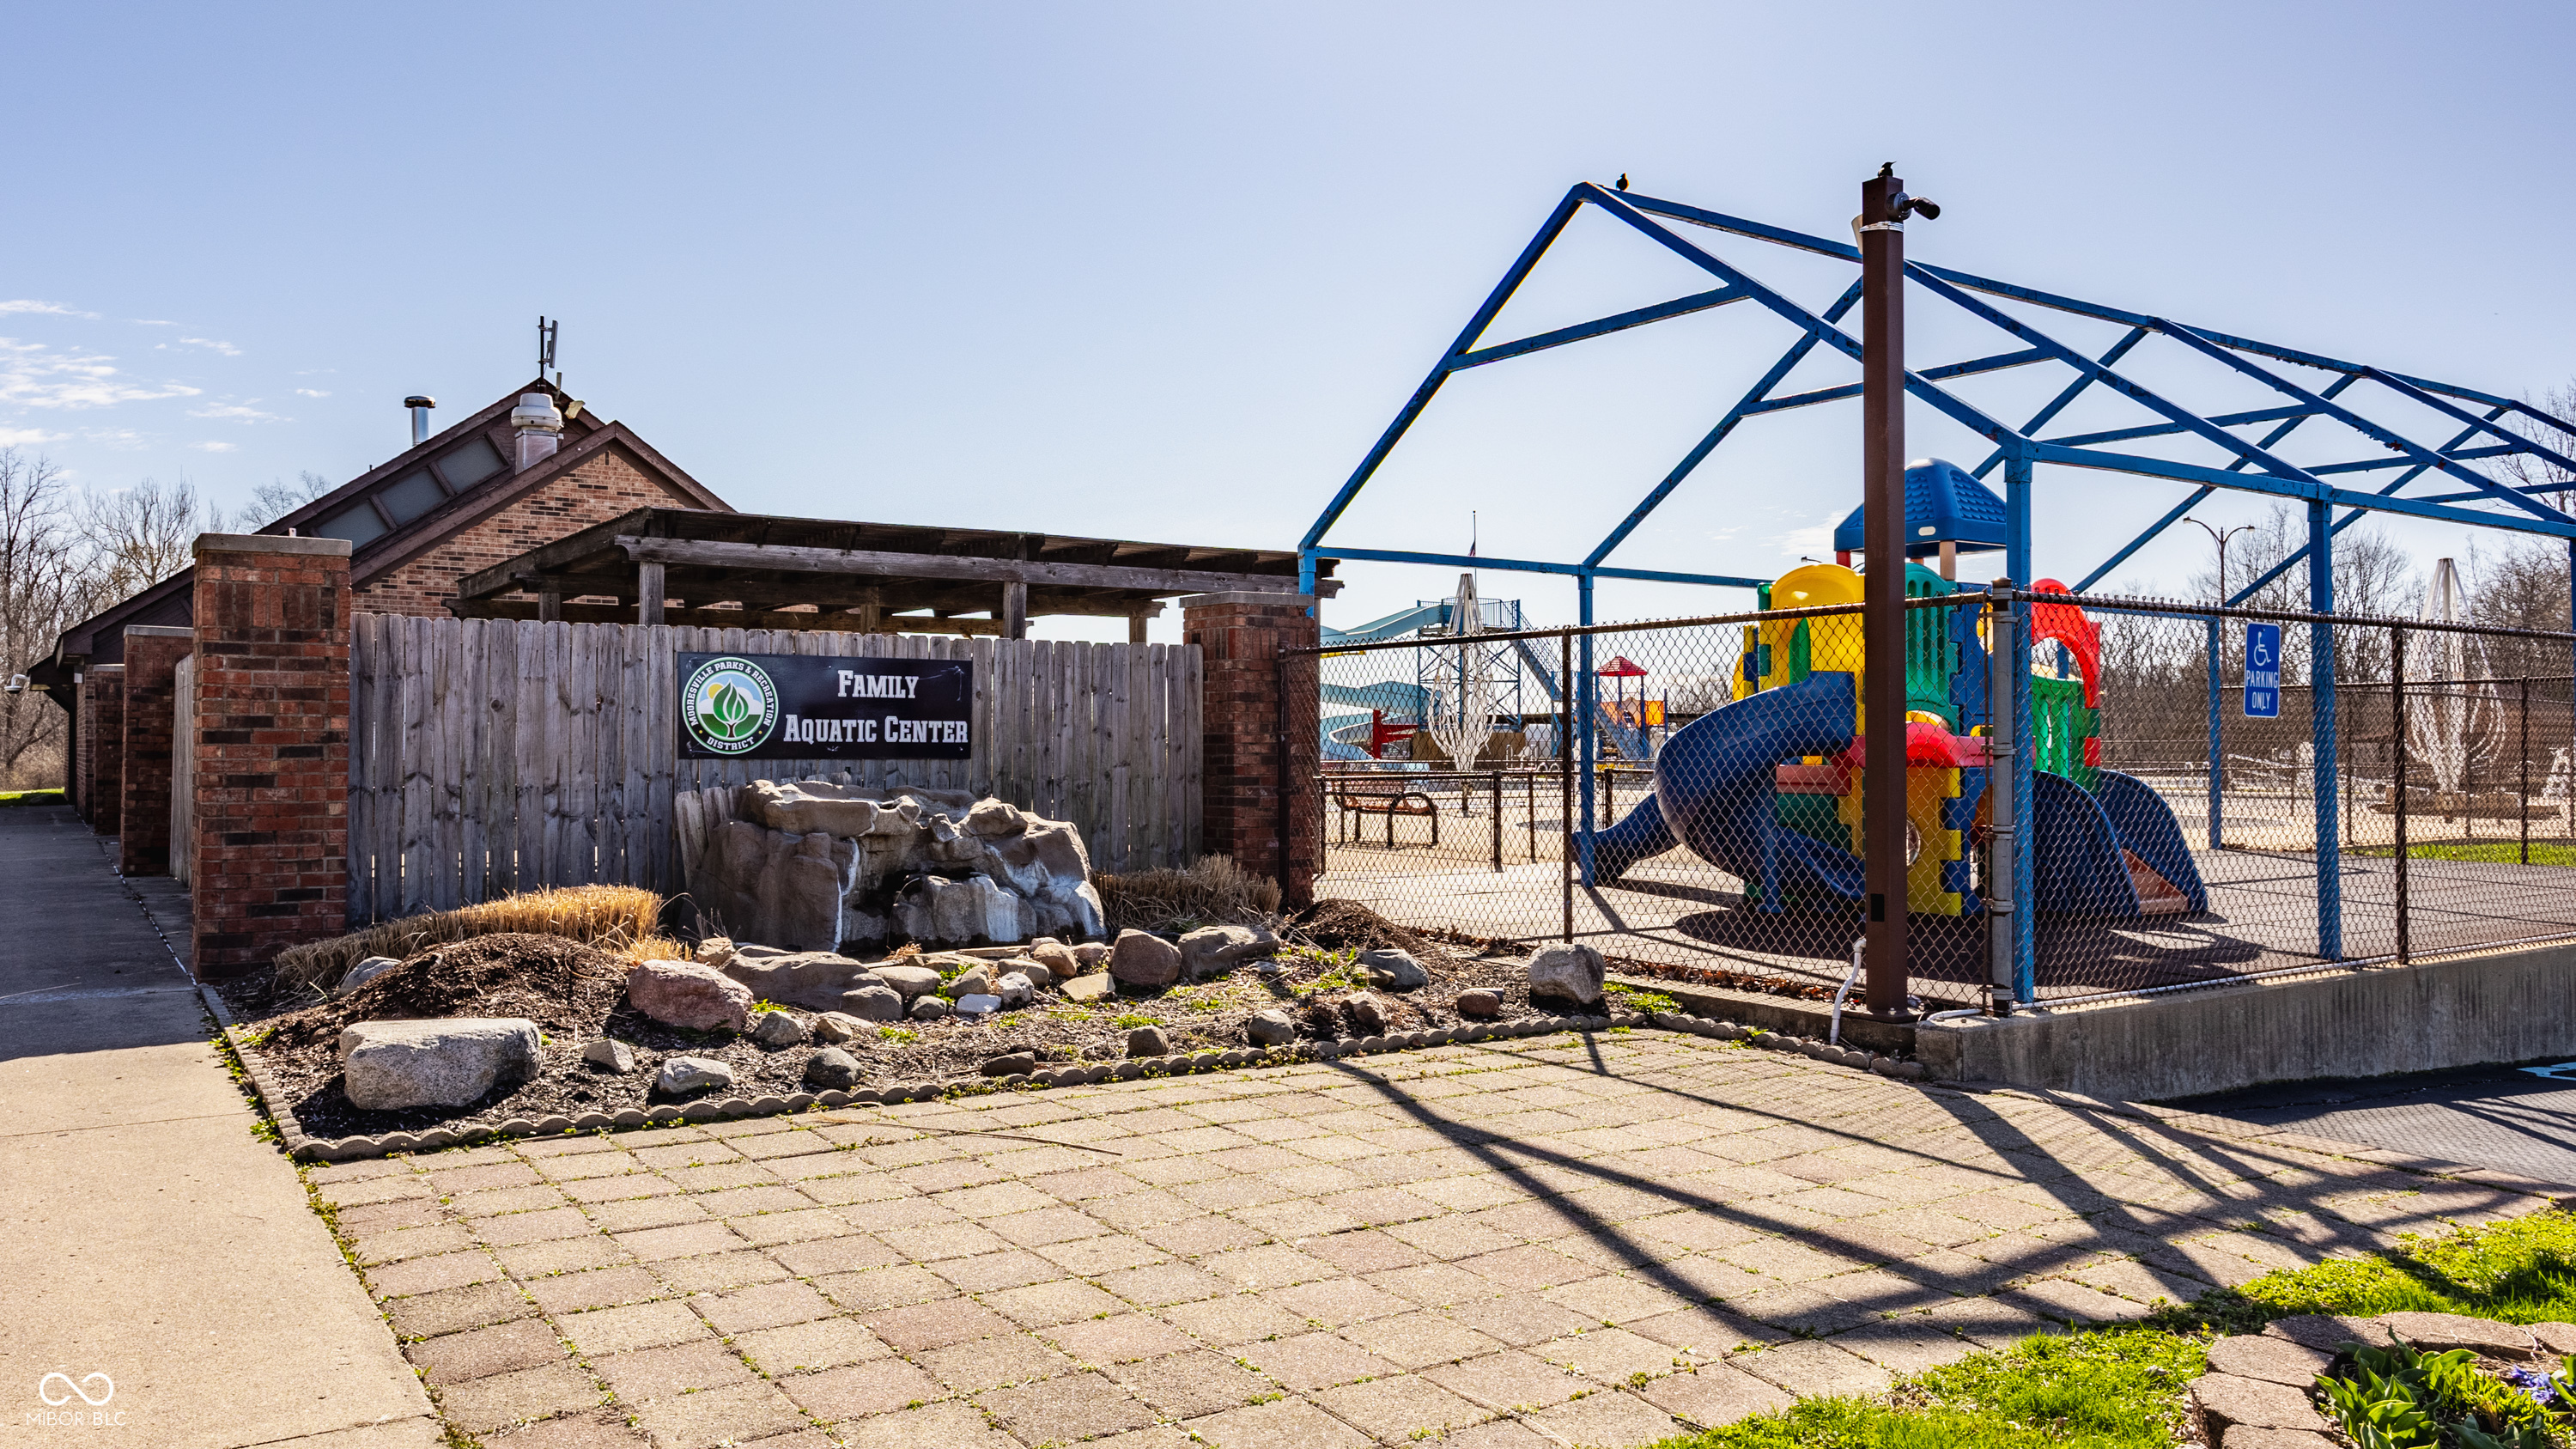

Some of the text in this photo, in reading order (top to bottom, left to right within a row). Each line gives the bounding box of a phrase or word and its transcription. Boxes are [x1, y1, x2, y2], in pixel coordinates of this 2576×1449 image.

[837, 669, 920, 699] FAMILY
[2245, 671, 2278, 689] PARKING
[687, 667, 714, 727] MOORESVILLE
[714, 661, 744, 672] PARKS
[751, 670, 775, 727] RECREATION
[2252, 691, 2271, 709] ONLY
[783, 714, 969, 745] AQUATIC CENTER
[707, 736, 755, 751] DISTRICT
